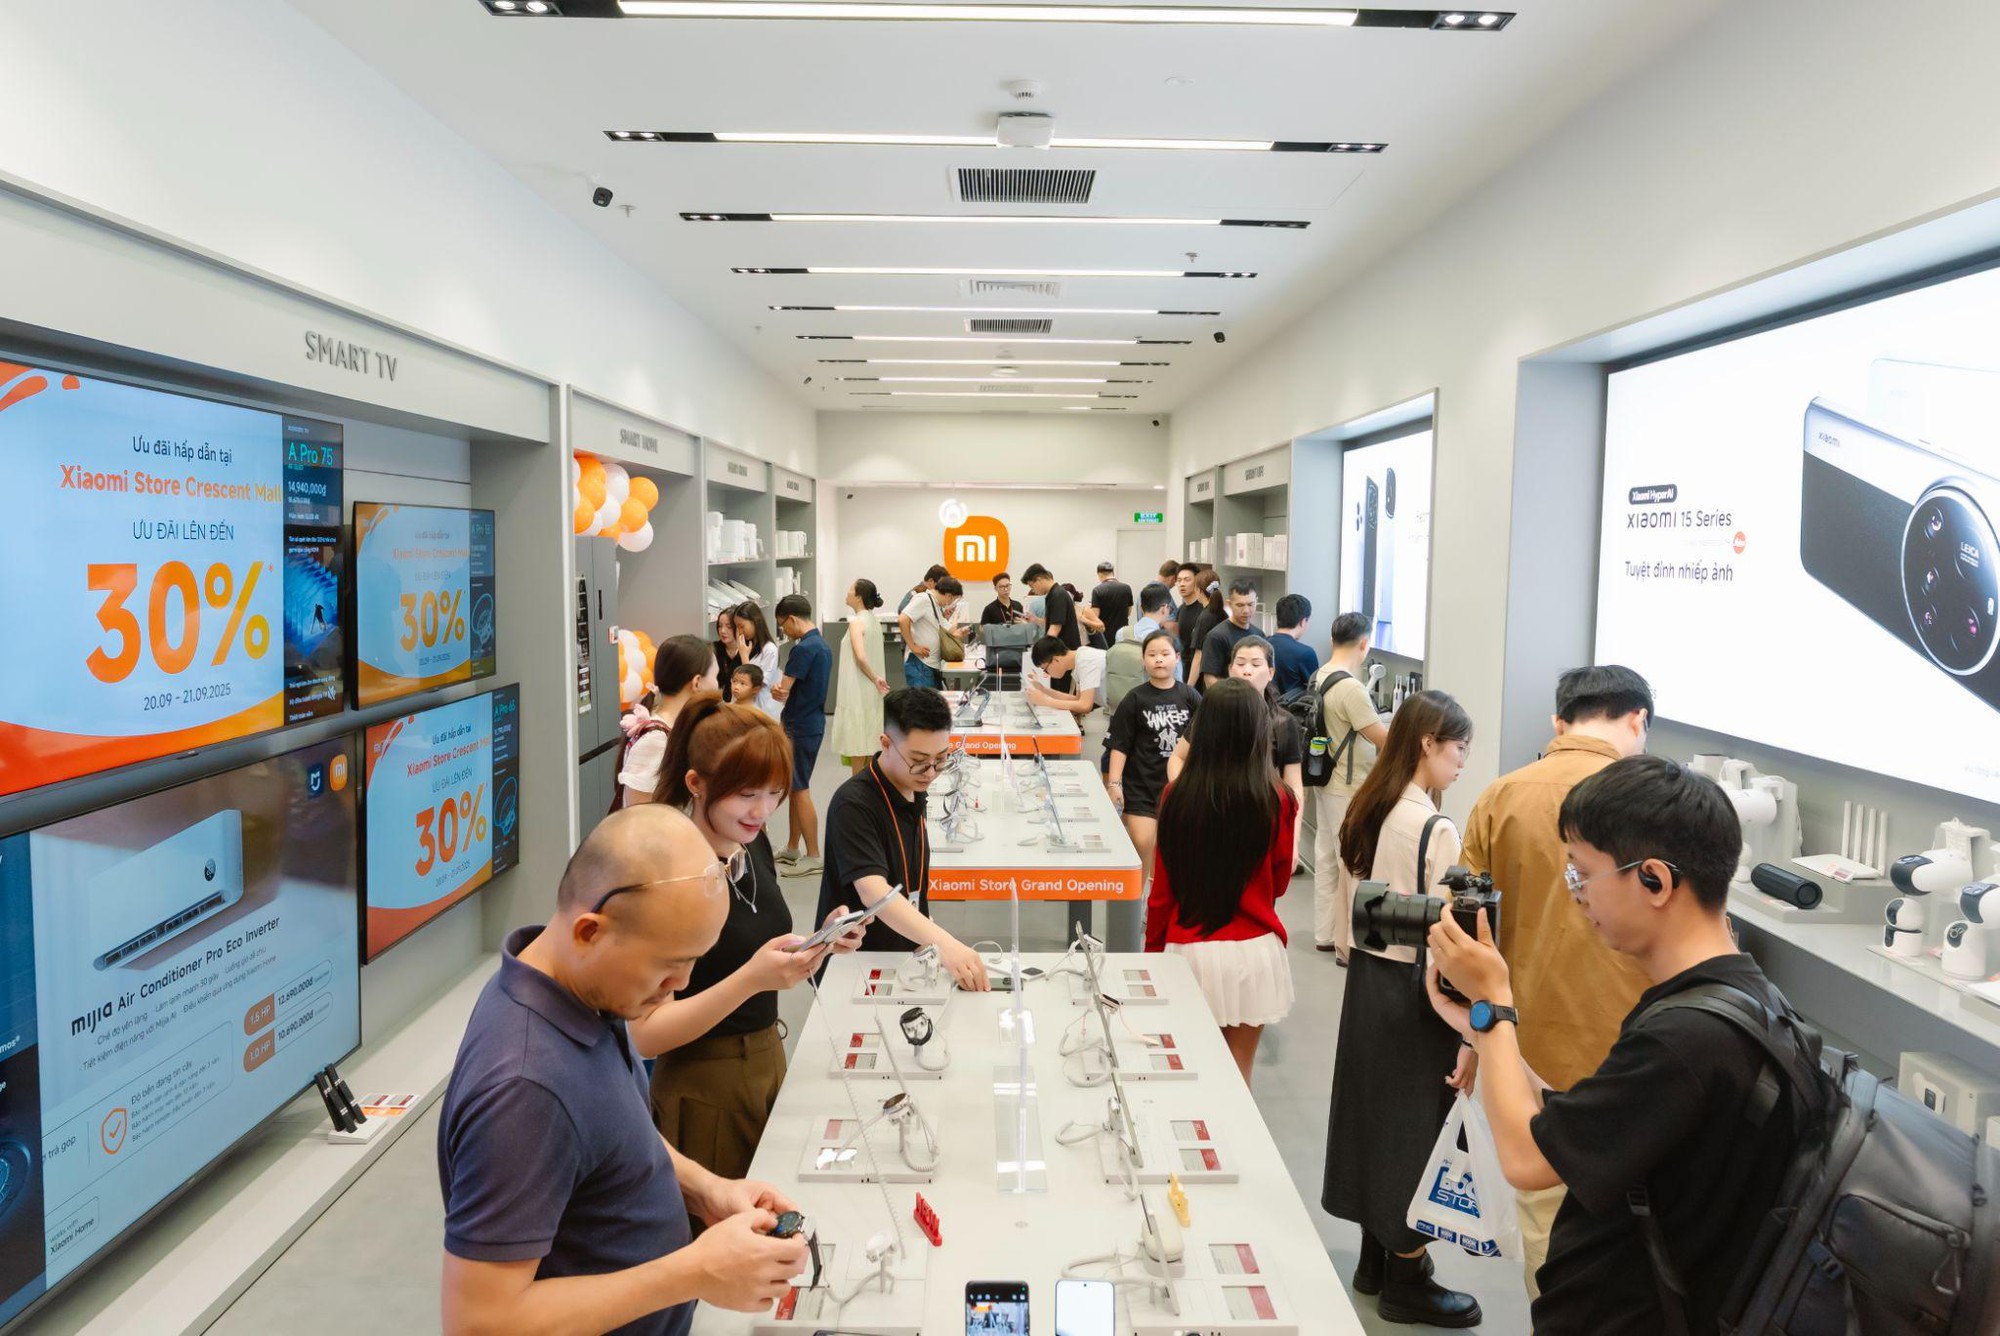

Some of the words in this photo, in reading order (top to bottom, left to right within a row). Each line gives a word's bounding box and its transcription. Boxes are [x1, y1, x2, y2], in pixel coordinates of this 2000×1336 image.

[304, 331, 370, 374] SMART
[375, 352, 397, 381] TV
[133, 435, 150, 453] Ưu
[154, 440, 171, 456] đãi
[174, 440, 194, 462] hấp
[197, 442, 217, 462] dẫn
[219, 449, 233, 466] tại
[288, 442, 297, 461] A
[300, 443, 319, 464] Pro
[321, 446, 333, 466] 75
[60, 464, 128, 492] Xiaomi
[134, 471, 180, 495] Store
[185, 476, 251, 501] Crescent
[254, 482, 282, 502] Mall
[133, 519, 153, 540] ƯU
[156, 520, 179, 540] ĐÃI
[182, 520, 206, 540] LÊN
[209, 519, 234, 541] ĐẾN
[1627, 511, 1677, 528] xiaomi
[1681, 511, 1692, 527] 15
[1696, 509, 1732, 527] Series
[1625, 561, 1650, 581] Tuyệt
[1678, 559, 1708, 584] nhiếp
[1712, 562, 1733, 581] ảnh
[400, 589, 466, 652] 30%
[143, 692, 172, 711] 20.09
[183, 682, 232, 704] 21.09.2025
[407, 759, 431, 777] Xiaomi
[433, 752, 451, 767] Store
[452, 741, 479, 759] Crescent
[415, 782, 487, 877] 30%
[929, 878, 975, 891] Xiaomi
[1021, 878, 1063, 891] Grand
[1066, 878, 1124, 893] Opening
[71, 1001, 113, 1036] mijia
[117, 992, 136, 1012] Air
[140, 958, 202, 998] Conditioner
[206, 947, 223, 964] Pro
[226, 937, 243, 953] Eco
[245, 916, 280, 943] Inverter
[261, 1004, 271, 1017] HP
[261, 1040, 271, 1053] HP
[48, 1145, 59, 1159] trả
[61, 1136, 76, 1152] góp
[50, 1232, 74, 1256] Xiaomi
[74, 1219, 95, 1238] Home
